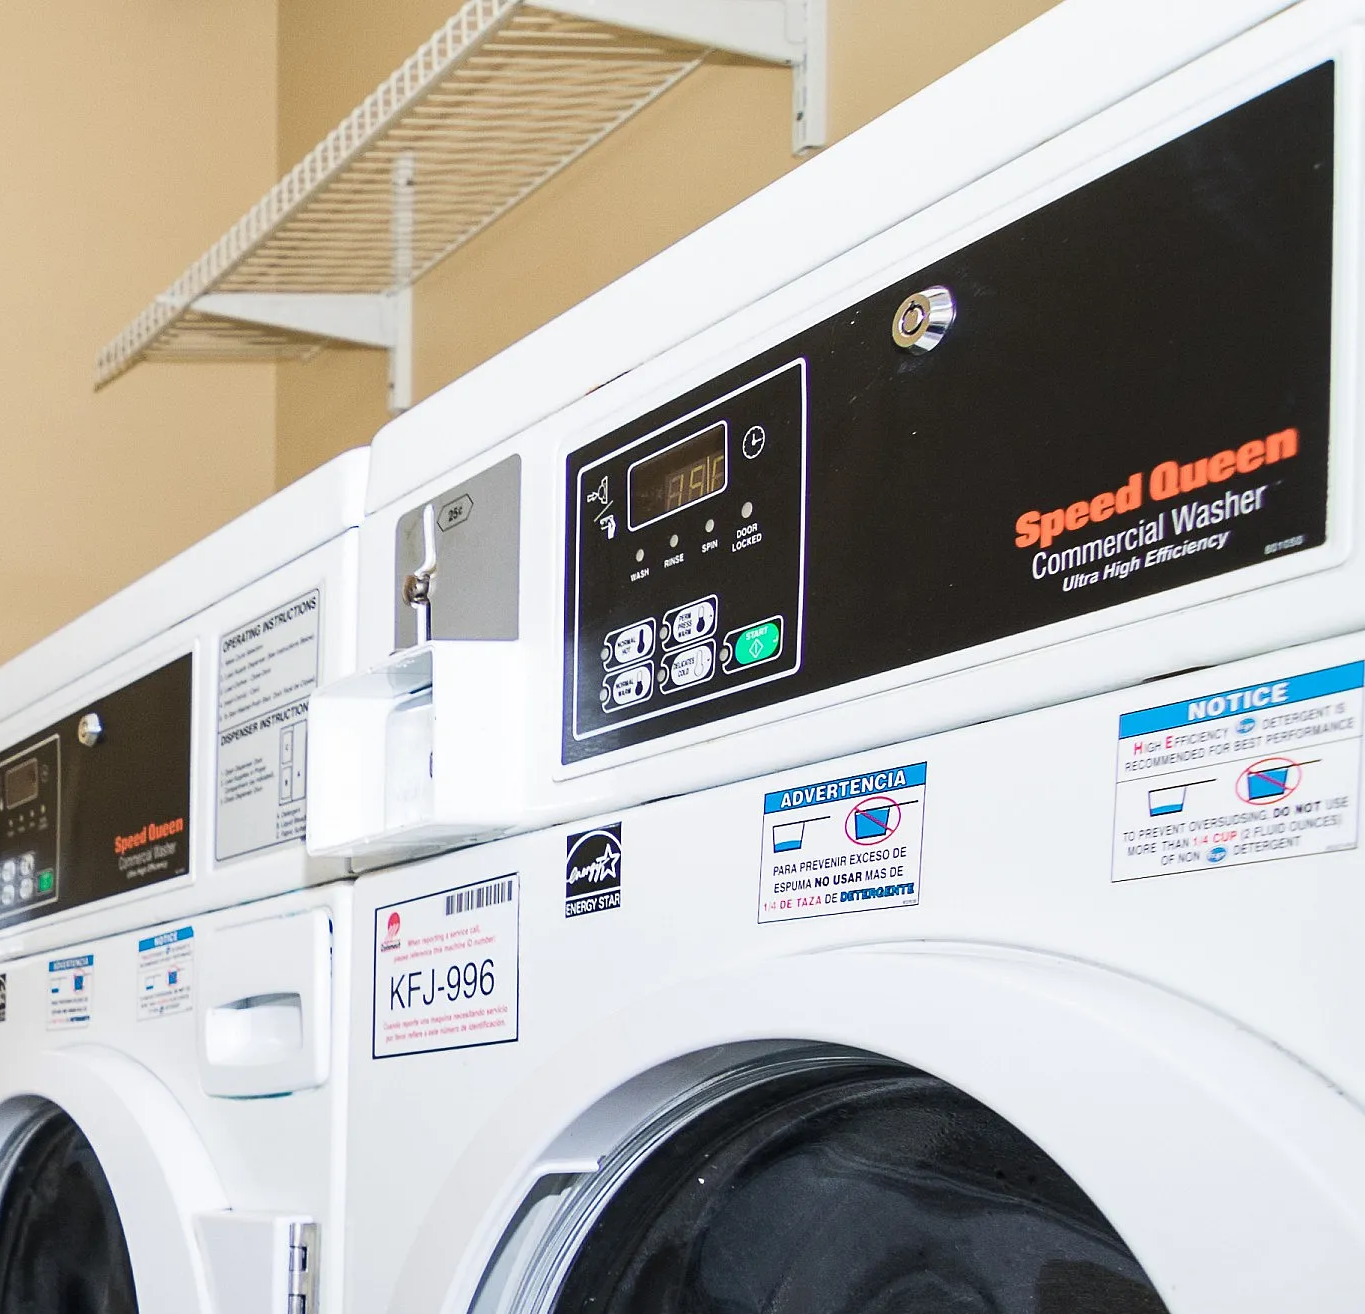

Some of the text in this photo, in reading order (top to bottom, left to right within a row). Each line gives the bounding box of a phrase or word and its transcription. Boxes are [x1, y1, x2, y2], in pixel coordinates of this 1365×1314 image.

[1014, 427, 1300, 549] Speed Queen
[701, 539, 718, 553] SPIN
[732, 533, 762, 552] LOCKED
[736, 523, 758, 539] DOOR
[1032, 484, 1267, 580] Commercial Washer
[630, 568, 650, 582] WASH
[664, 553, 684, 568] RINSE
[1062, 572, 1099, 592] Ultra
[1103, 556, 1140, 586] High
[1145, 530, 1231, 569] Efficiency
[223, 596, 316, 653] OPERATING INSTRUCTIONS
[678, 621, 692, 630] PRESS
[746, 626, 769, 640] START
[618, 637, 636, 648] NORMAL
[616, 679, 634, 689] NORMAL
[1187, 681, 1290, 721] NOTICE
[221, 722, 258, 746] DISPENSER
[1125, 749, 1205, 772] RECOMMENDED
[1209, 743, 1231, 755] FOR
[1234, 736, 1262, 752] BEST
[1266, 717, 1355, 744] PERFORMANCE
[1133, 739, 1167, 756] HIGH
[1165, 727, 1229, 749] EFFICIENCY
[1262, 708, 1332, 730] DETERGENT
[1334, 703, 1346, 715] IS
[780, 770, 906, 809] ADVERTENCIA
[1124, 831, 1135, 842] TO
[1139, 823, 1186, 839] PREVENT
[1273, 807, 1290, 819] DO
[1296, 800, 1321, 813] NOT
[1326, 796, 1349, 810] USE
[115, 818, 183, 855] Speed Queen
[1127, 843, 1157, 856] MORE
[1162, 839, 1189, 851] THAN
[1212, 830, 1237, 843] CUP
[1253, 824, 1285, 837] FLUID
[1289, 815, 1343, 832] OUNCES)
[773, 847, 907, 877] PARA PREVENIR EXCESO DE
[1160, 854, 1175, 866] OF
[1177, 851, 1200, 863] NON
[1233, 836, 1300, 856] DETERGENT
[774, 866, 904, 894] ESPUMA NO USAR MAS DE
[567, 893, 620, 916] ENERGY STAR
[780, 899, 792, 910] DE
[796, 895, 822, 908] TAZA
[824, 892, 838, 904] DE
[840, 882, 915, 903] DETERGENTE
[390, 959, 495, 1010] KFJ-996
